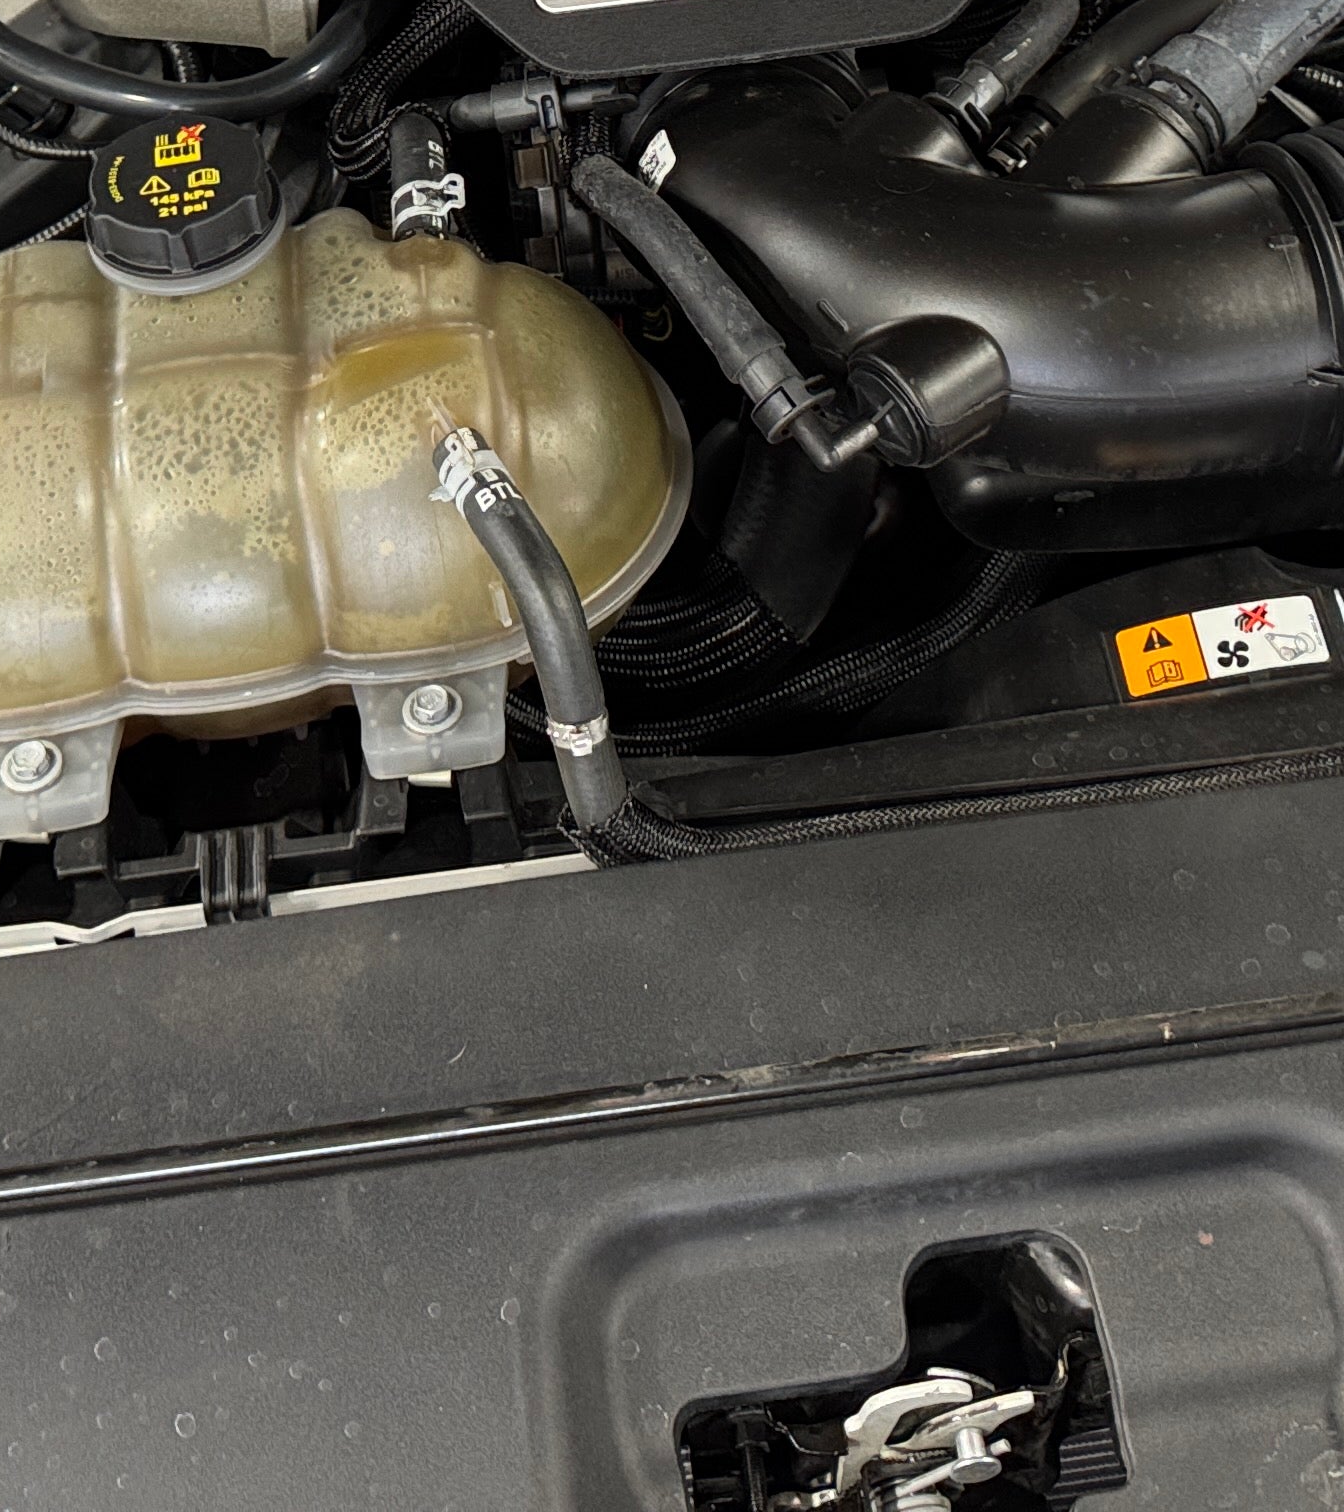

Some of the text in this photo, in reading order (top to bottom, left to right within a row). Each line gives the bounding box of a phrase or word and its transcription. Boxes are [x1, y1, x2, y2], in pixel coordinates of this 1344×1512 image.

[149, 189, 215, 207] 145 kPa
[158, 205, 178, 218] 21
[474, 481, 523, 513] BTL
